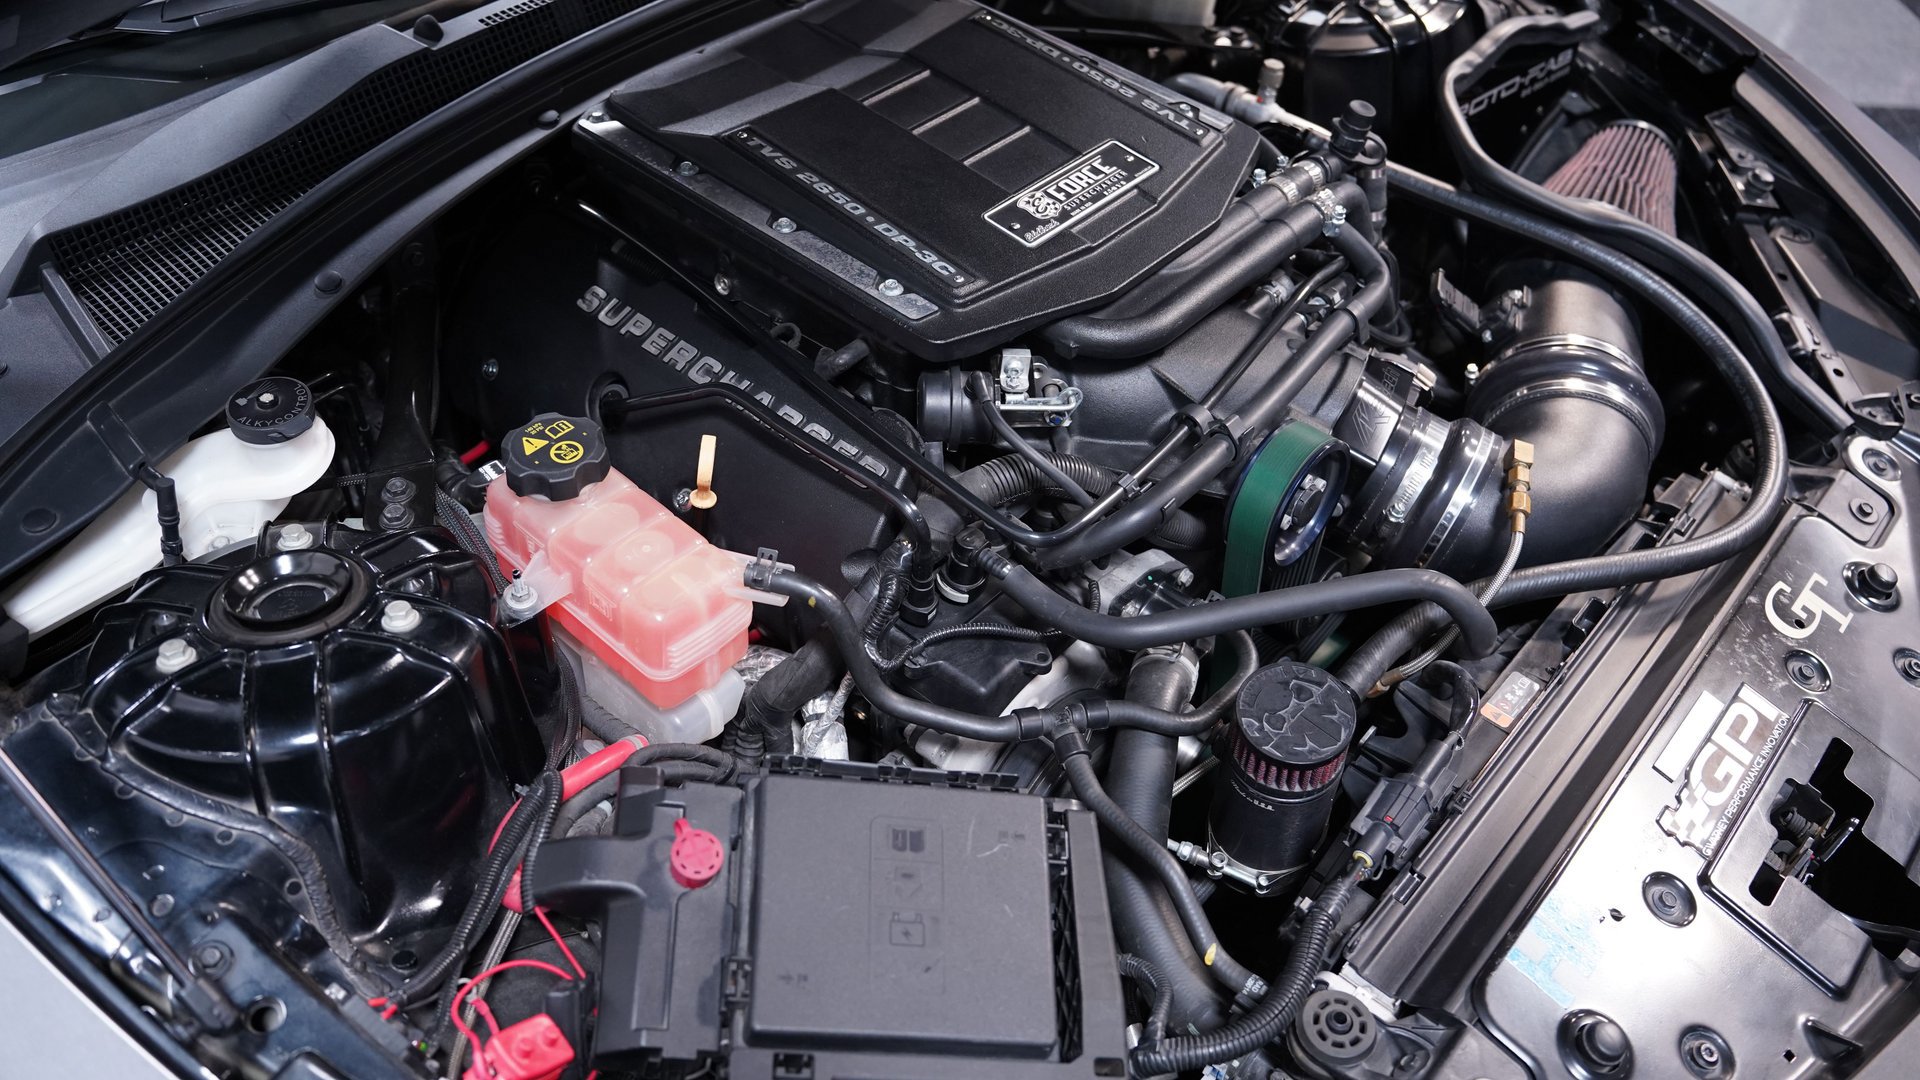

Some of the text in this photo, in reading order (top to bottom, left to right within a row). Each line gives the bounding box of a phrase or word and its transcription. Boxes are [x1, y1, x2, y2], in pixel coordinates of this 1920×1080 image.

[1072, 61, 1137, 98] 2650
[1141, 99, 1190, 130] TVS
[747, 137, 956, 276] TVS 2650 DP-3C
[1046, 158, 1118, 201] FORCE
[1063, 170, 1129, 211] SUPERCHARGER
[1764, 572, 1855, 639] GT
[1690, 681, 1782, 808] GPI
[1724, 752, 1766, 820] PERFORMANCE
[1760, 713, 1792, 762] INNOVATION
